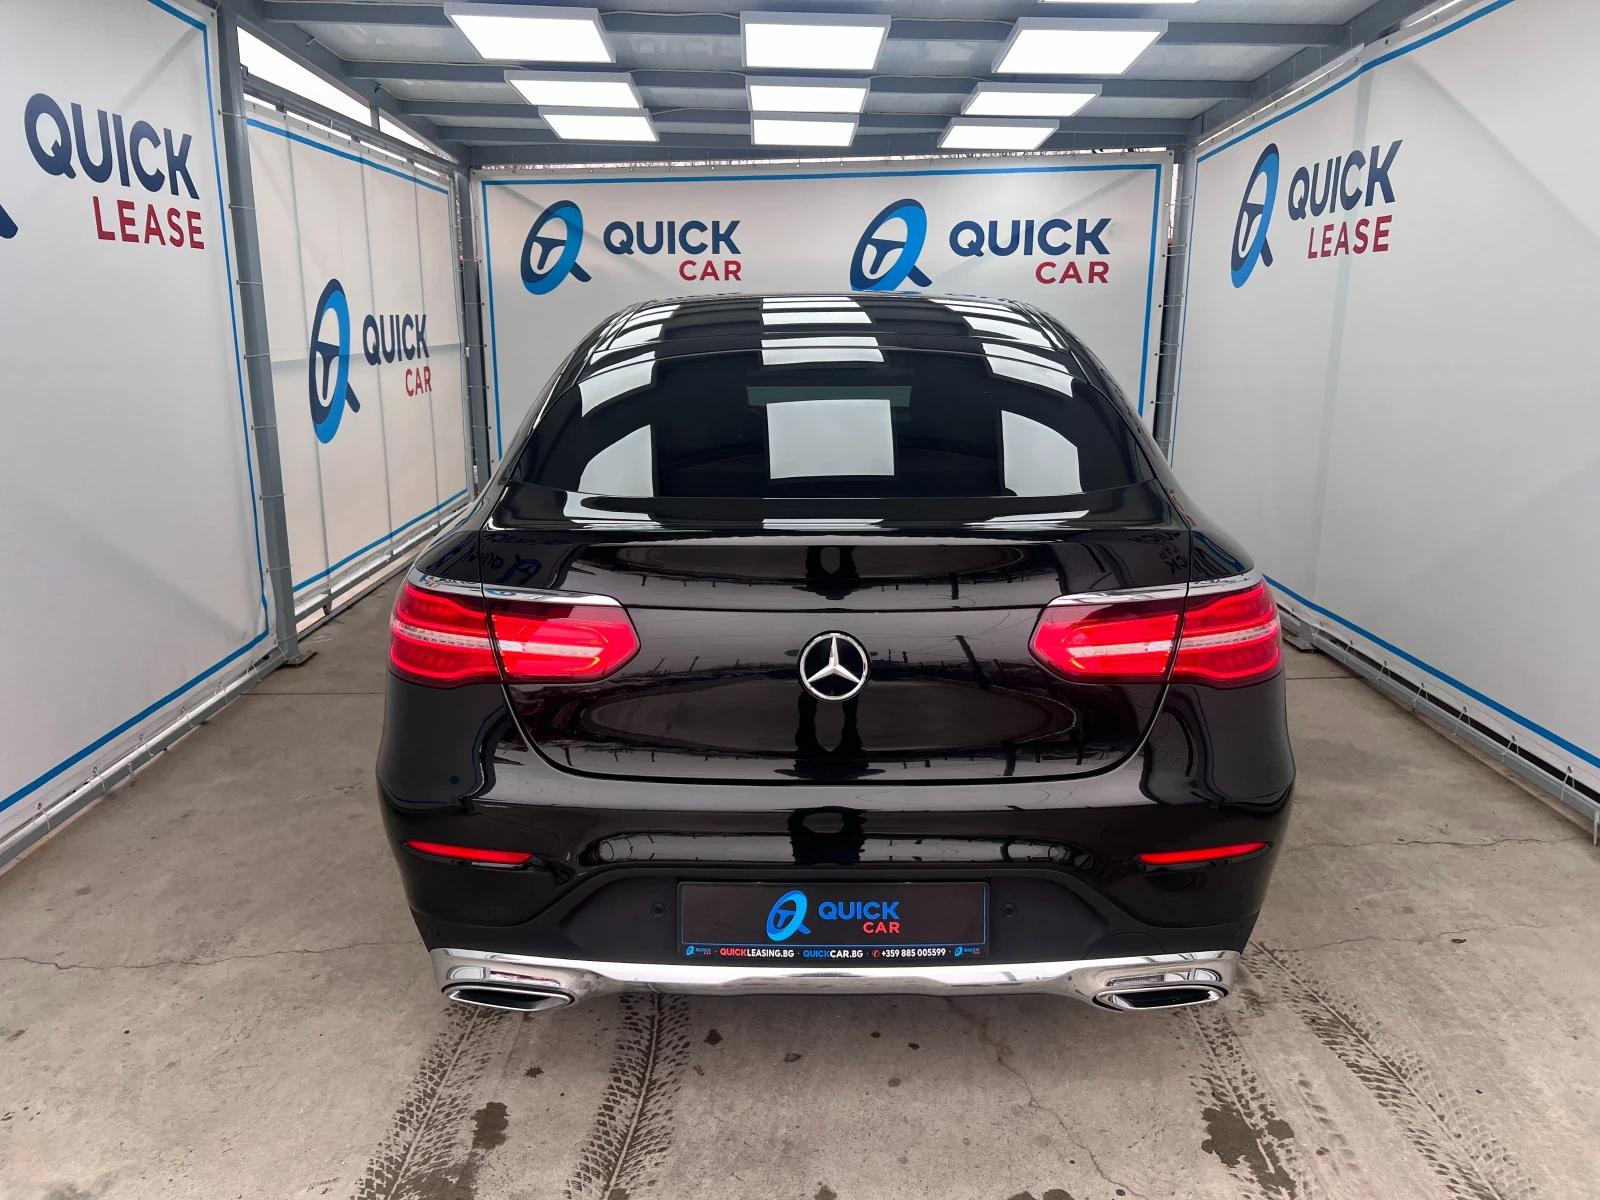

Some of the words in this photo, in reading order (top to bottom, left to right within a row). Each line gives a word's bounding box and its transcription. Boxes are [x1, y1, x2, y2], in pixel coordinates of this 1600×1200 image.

[24, 92, 200, 200] QUICK
[1287, 139, 1403, 221] QUICK
[93, 195, 205, 250] LEASE
[603, 220, 741, 256] QUICK
[949, 217, 1112, 258] QUICK
[1307, 214, 1393, 259] LEASE
[678, 260, 743, 281] CAR
[1035, 261, 1110, 284] CAR
[362, 313, 430, 367] QUICK
[404, 365, 432, 397] CAR
[818, 901, 900, 921] QUICK
[862, 921, 900, 934] CAR
[719, 947, 795, 958] QUICKLEASING.BG
[802, 949, 864, 959] QUICKCAR.BG
[881, 948, 900, 958] +359
[901, 948, 916, 957] 885
[917, 947, 946, 957] 005599
